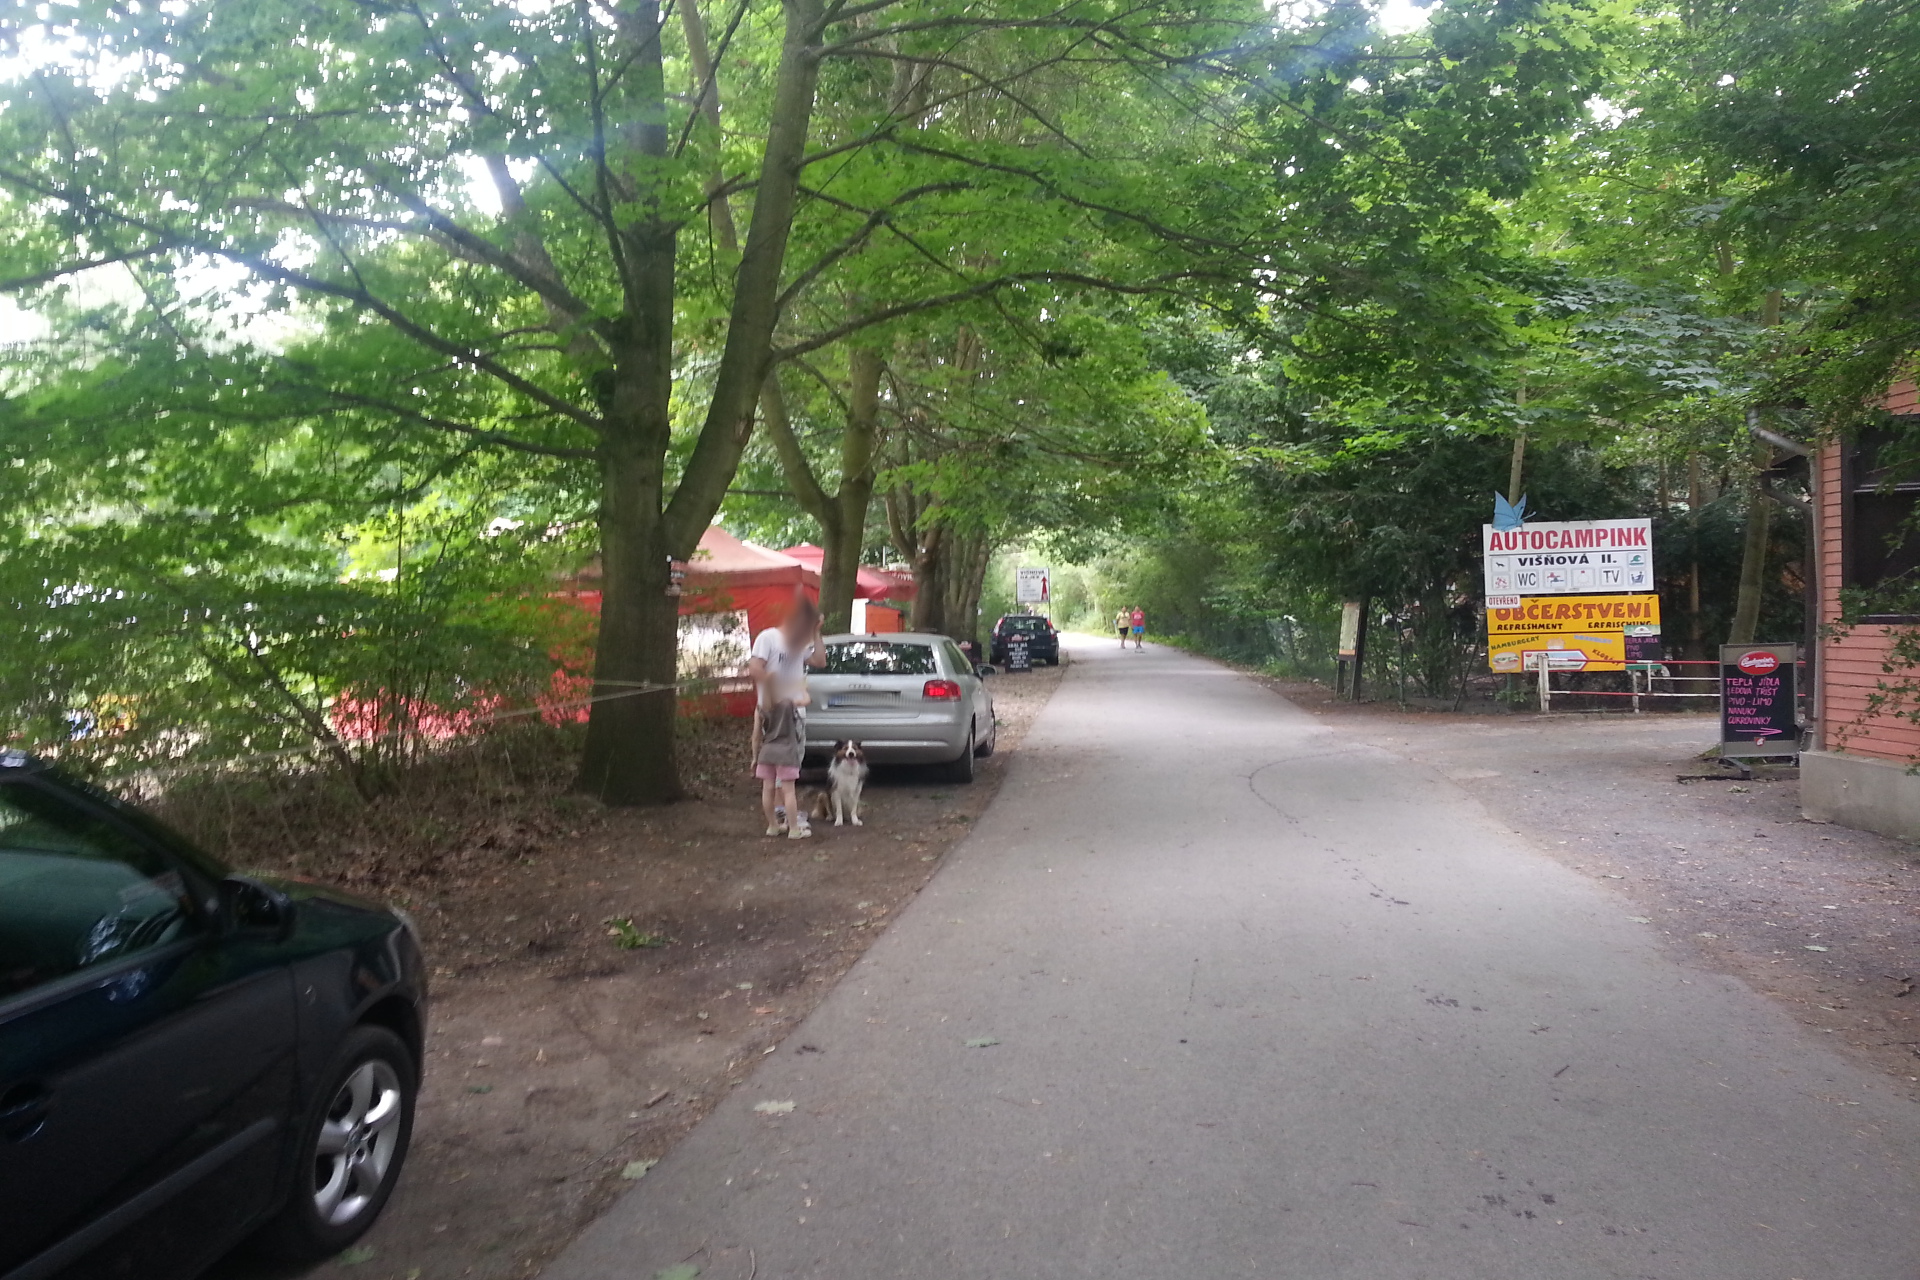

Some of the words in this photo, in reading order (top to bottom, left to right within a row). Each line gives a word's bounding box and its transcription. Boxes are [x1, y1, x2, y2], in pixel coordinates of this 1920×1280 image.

[1489, 527, 1647, 551] AUTOCAMPINK
[1518, 553, 1589, 567] VIŠŇOVÁ
[1518, 572, 1537, 586] WC
[1602, 570, 1620, 583] TV
[1495, 596, 1654, 621] OBČERSTVENÍ
